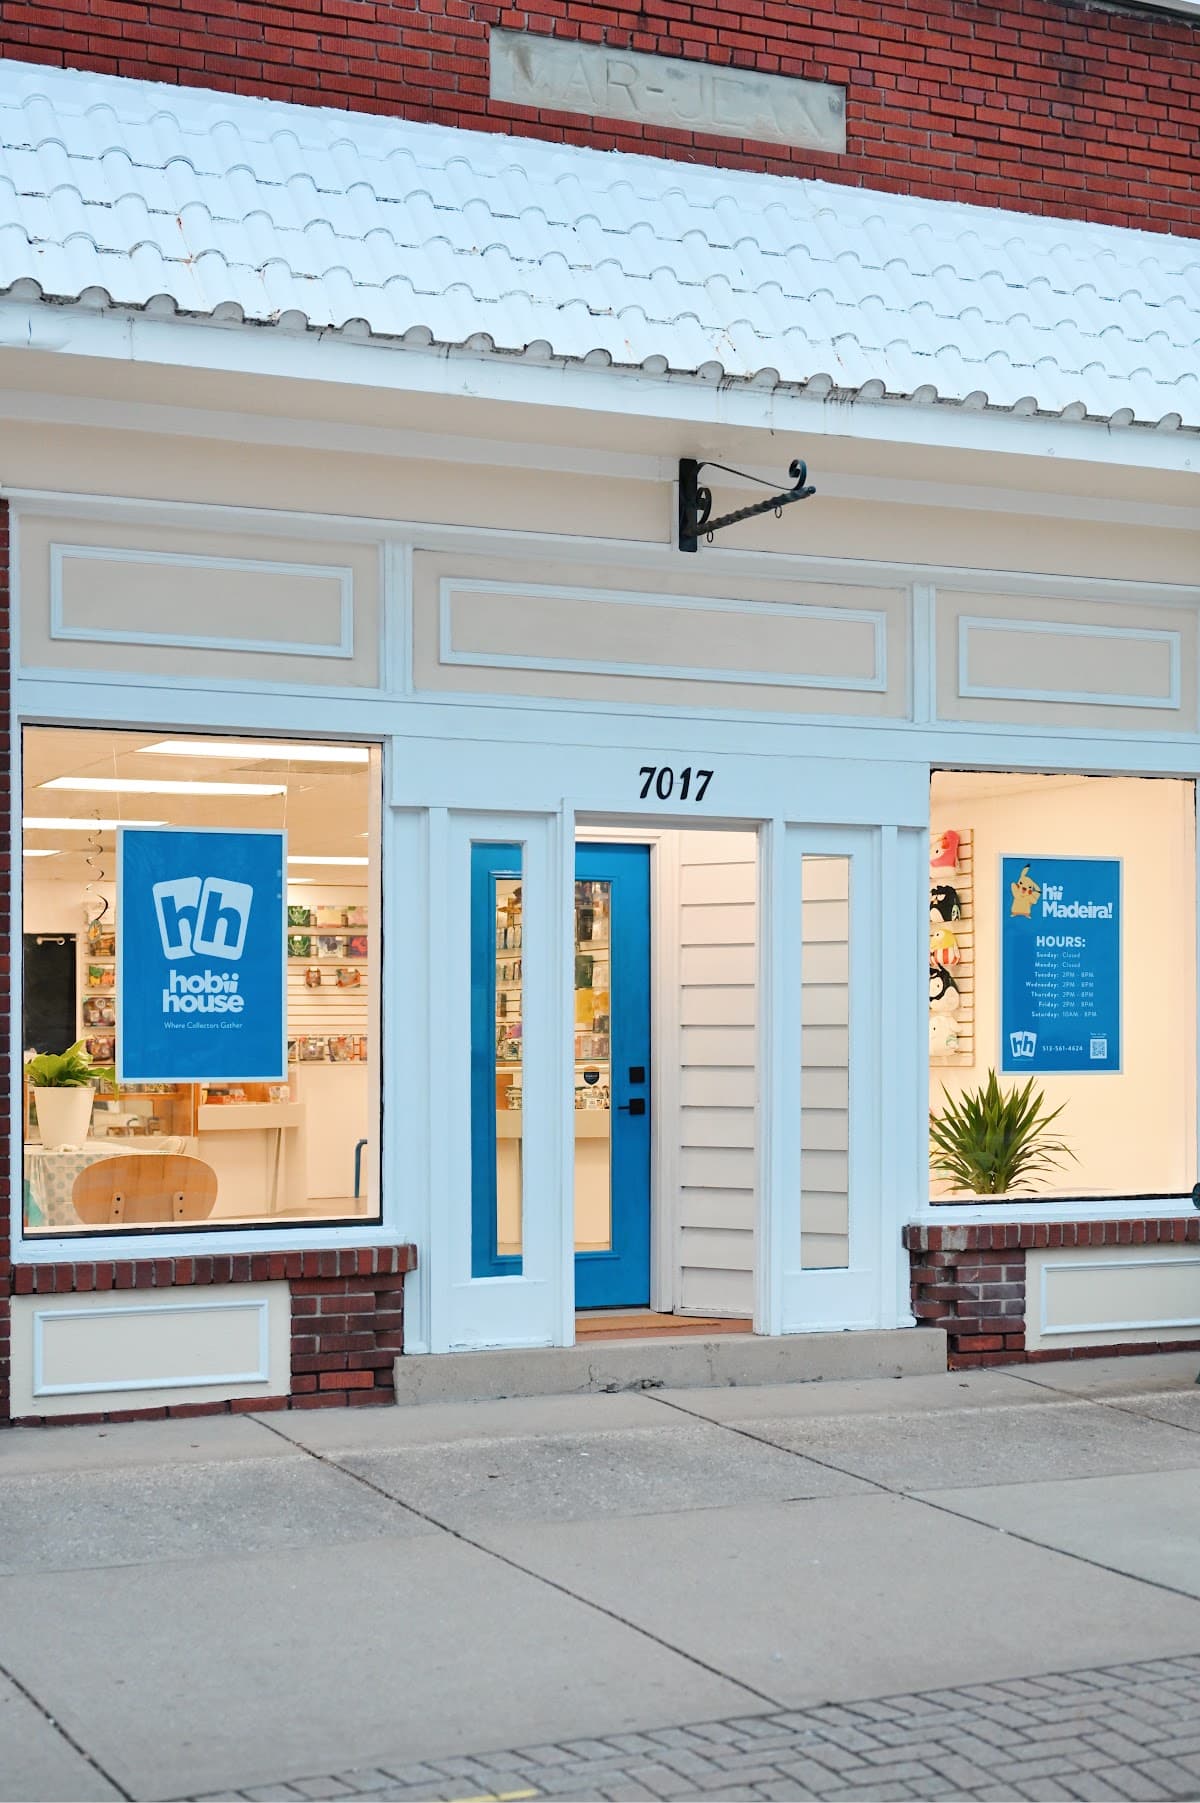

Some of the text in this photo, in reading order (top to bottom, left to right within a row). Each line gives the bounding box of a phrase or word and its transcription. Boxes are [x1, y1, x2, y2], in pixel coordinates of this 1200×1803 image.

[639, 766, 715, 801] 7017
[1042, 882, 1064, 901] hii
[1042, 900, 1113, 919] Madeira!
[1036, 935, 1086, 948] HOURS:
[1036, 951, 1059, 960] Sunday:
[1034, 961, 1059, 970] Monday:
[1034, 971, 1059, 979] Tuesday:
[169, 969, 240, 993] hobii
[1025, 981, 1059, 989] Wednesday:
[1031, 991, 1059, 999] Thursday:
[162, 988, 245, 1013] house
[1038, 1001, 1059, 1009] Friday:
[1031, 1011, 1059, 1019] Saturday:
[164, 1021, 243, 1029] Where Collectors Gather
